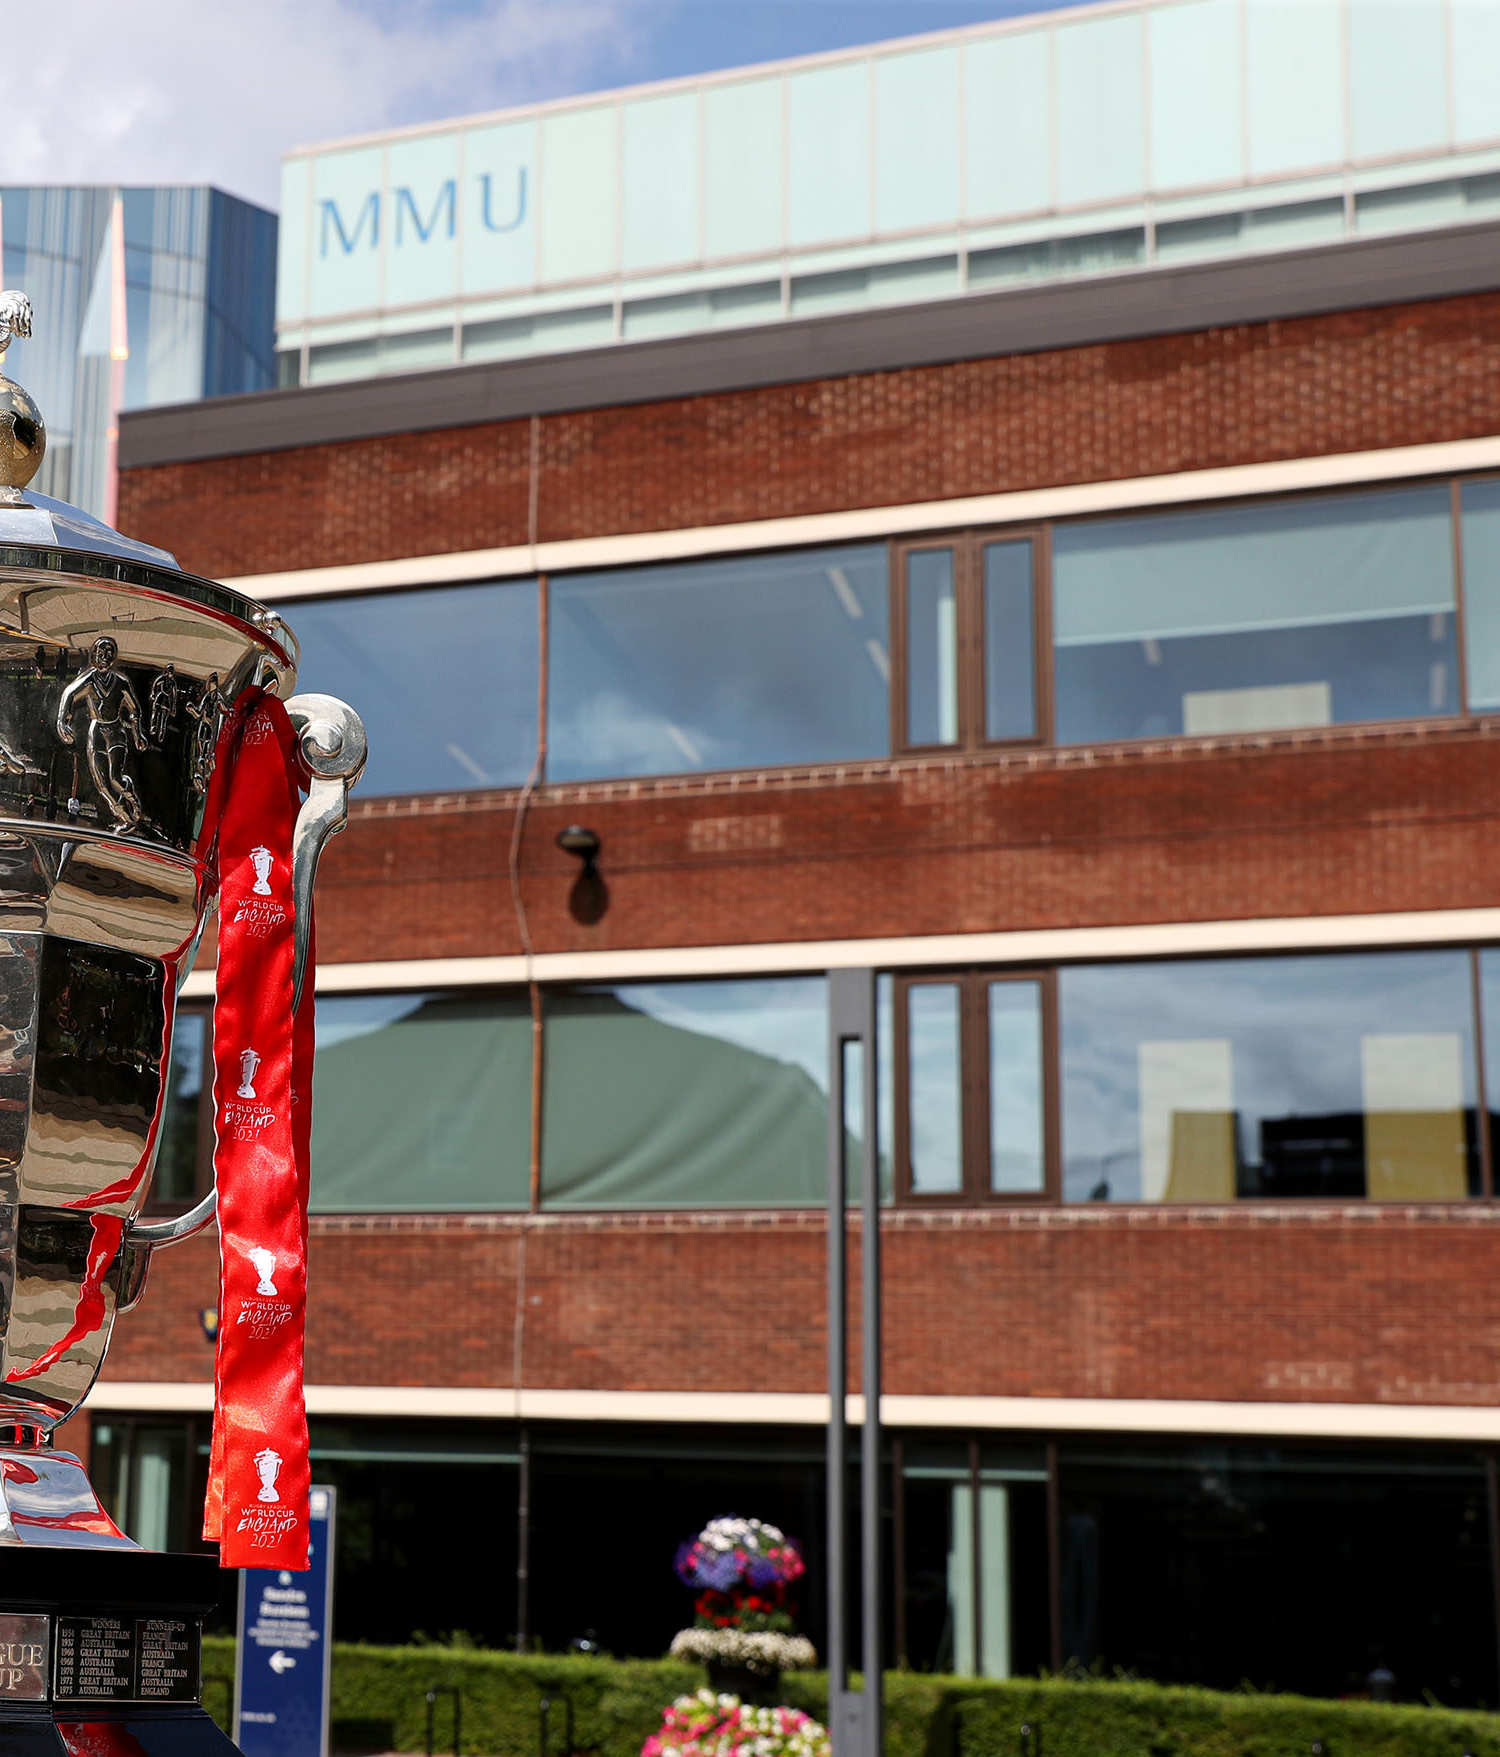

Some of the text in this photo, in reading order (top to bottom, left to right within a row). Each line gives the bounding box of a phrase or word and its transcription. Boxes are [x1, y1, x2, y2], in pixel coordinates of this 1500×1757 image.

[317, 165, 527, 261] MMU
[234, 908, 286, 924] ENGLAND
[254, 1106, 271, 1114] CUP
[237, 1310, 292, 1326] ENGLAND
[237, 1518, 297, 1534] ENGLAND
[251, 1534, 282, 1548] 2021
[92, 1620, 120, 1629] WINNERS
[81, 1630, 102, 1638] GREAT
[105, 1631, 130, 1639] BRITAIN
[81, 1640, 115, 1648] AUSTRALIA
[80, 1649, 102, 1657] GREAT
[104, 1650, 129, 1658] BRITAIN
[142, 1650, 174, 1659] AUSTRALIA
[80, 1658, 115, 1666] AUSTRALIA
[142, 1660, 165, 1668] FRANCE
[80, 1668, 114, 1676] AUSTRALIA
[141, 1669, 162, 1677] GREAT
[79, 1677, 101, 1685] GREAT
[141, 1678, 174, 1686] AUSTRALIA
[79, 1687, 114, 1695] AUSTRALIA
